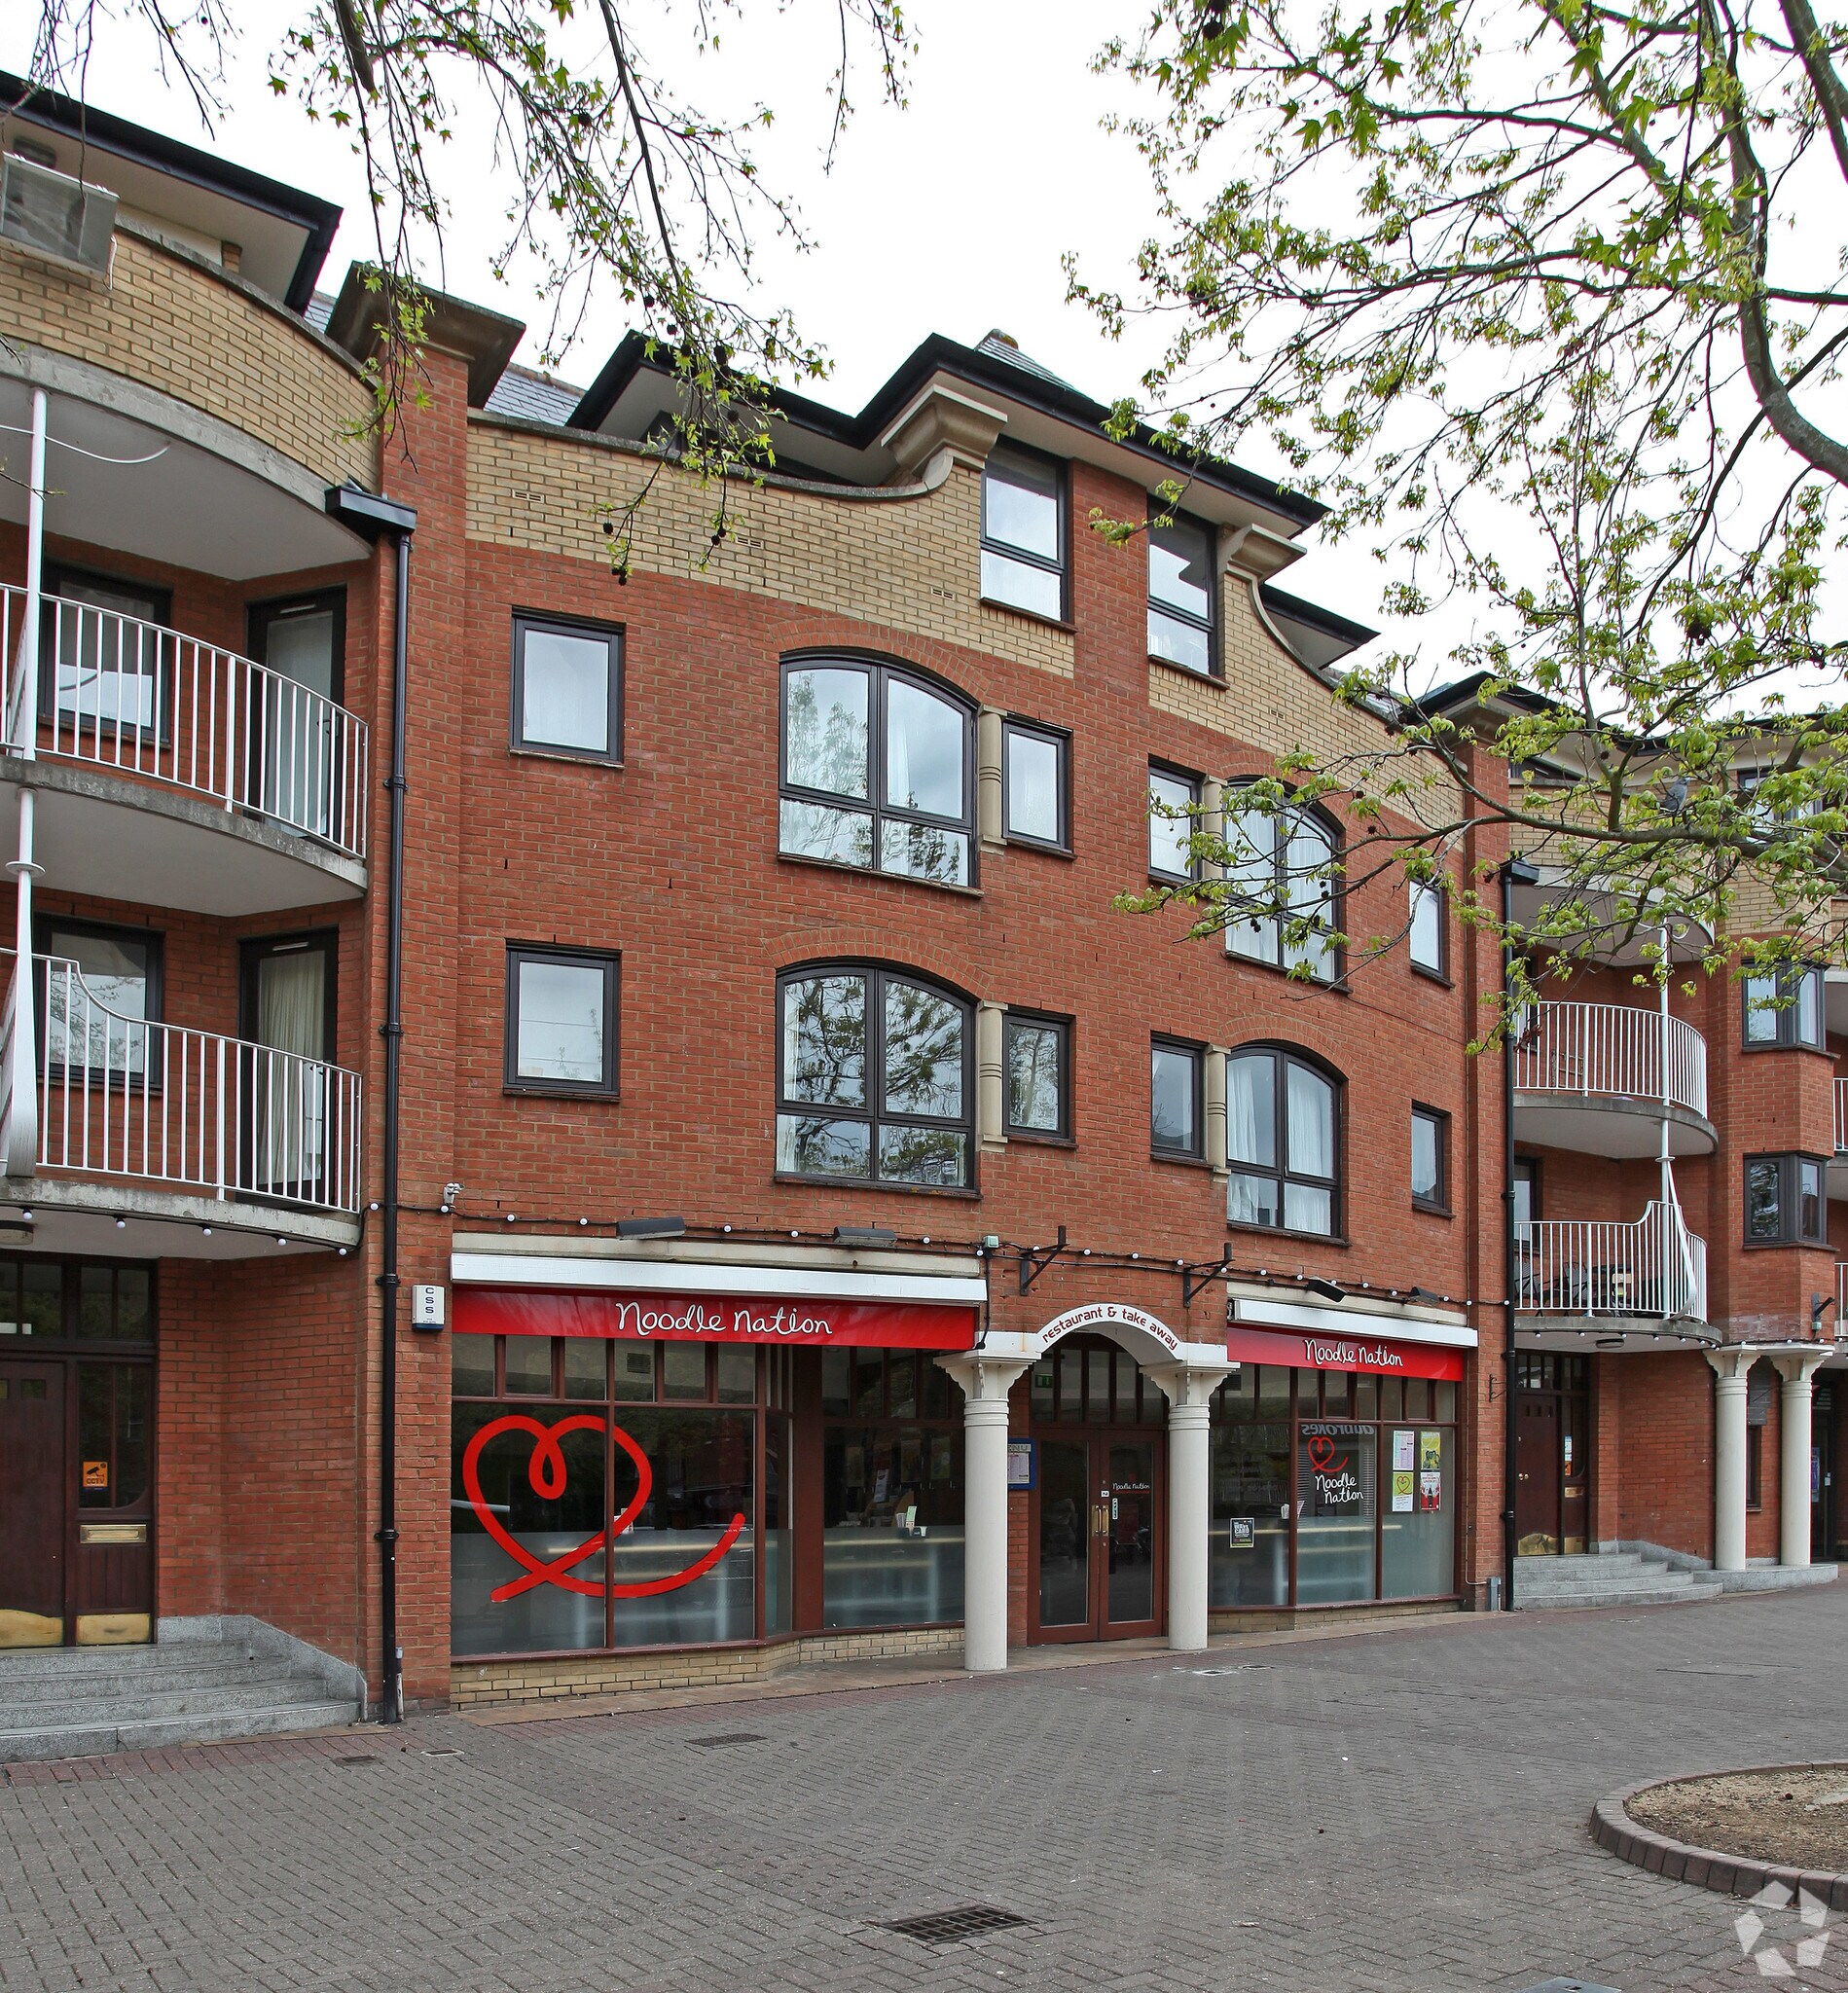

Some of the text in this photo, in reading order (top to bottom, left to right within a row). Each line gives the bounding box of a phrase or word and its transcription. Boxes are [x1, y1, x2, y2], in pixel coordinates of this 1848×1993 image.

[425, 1286, 435, 1314] CSS
[1042, 1306, 1178, 1351] restaurant & take away
